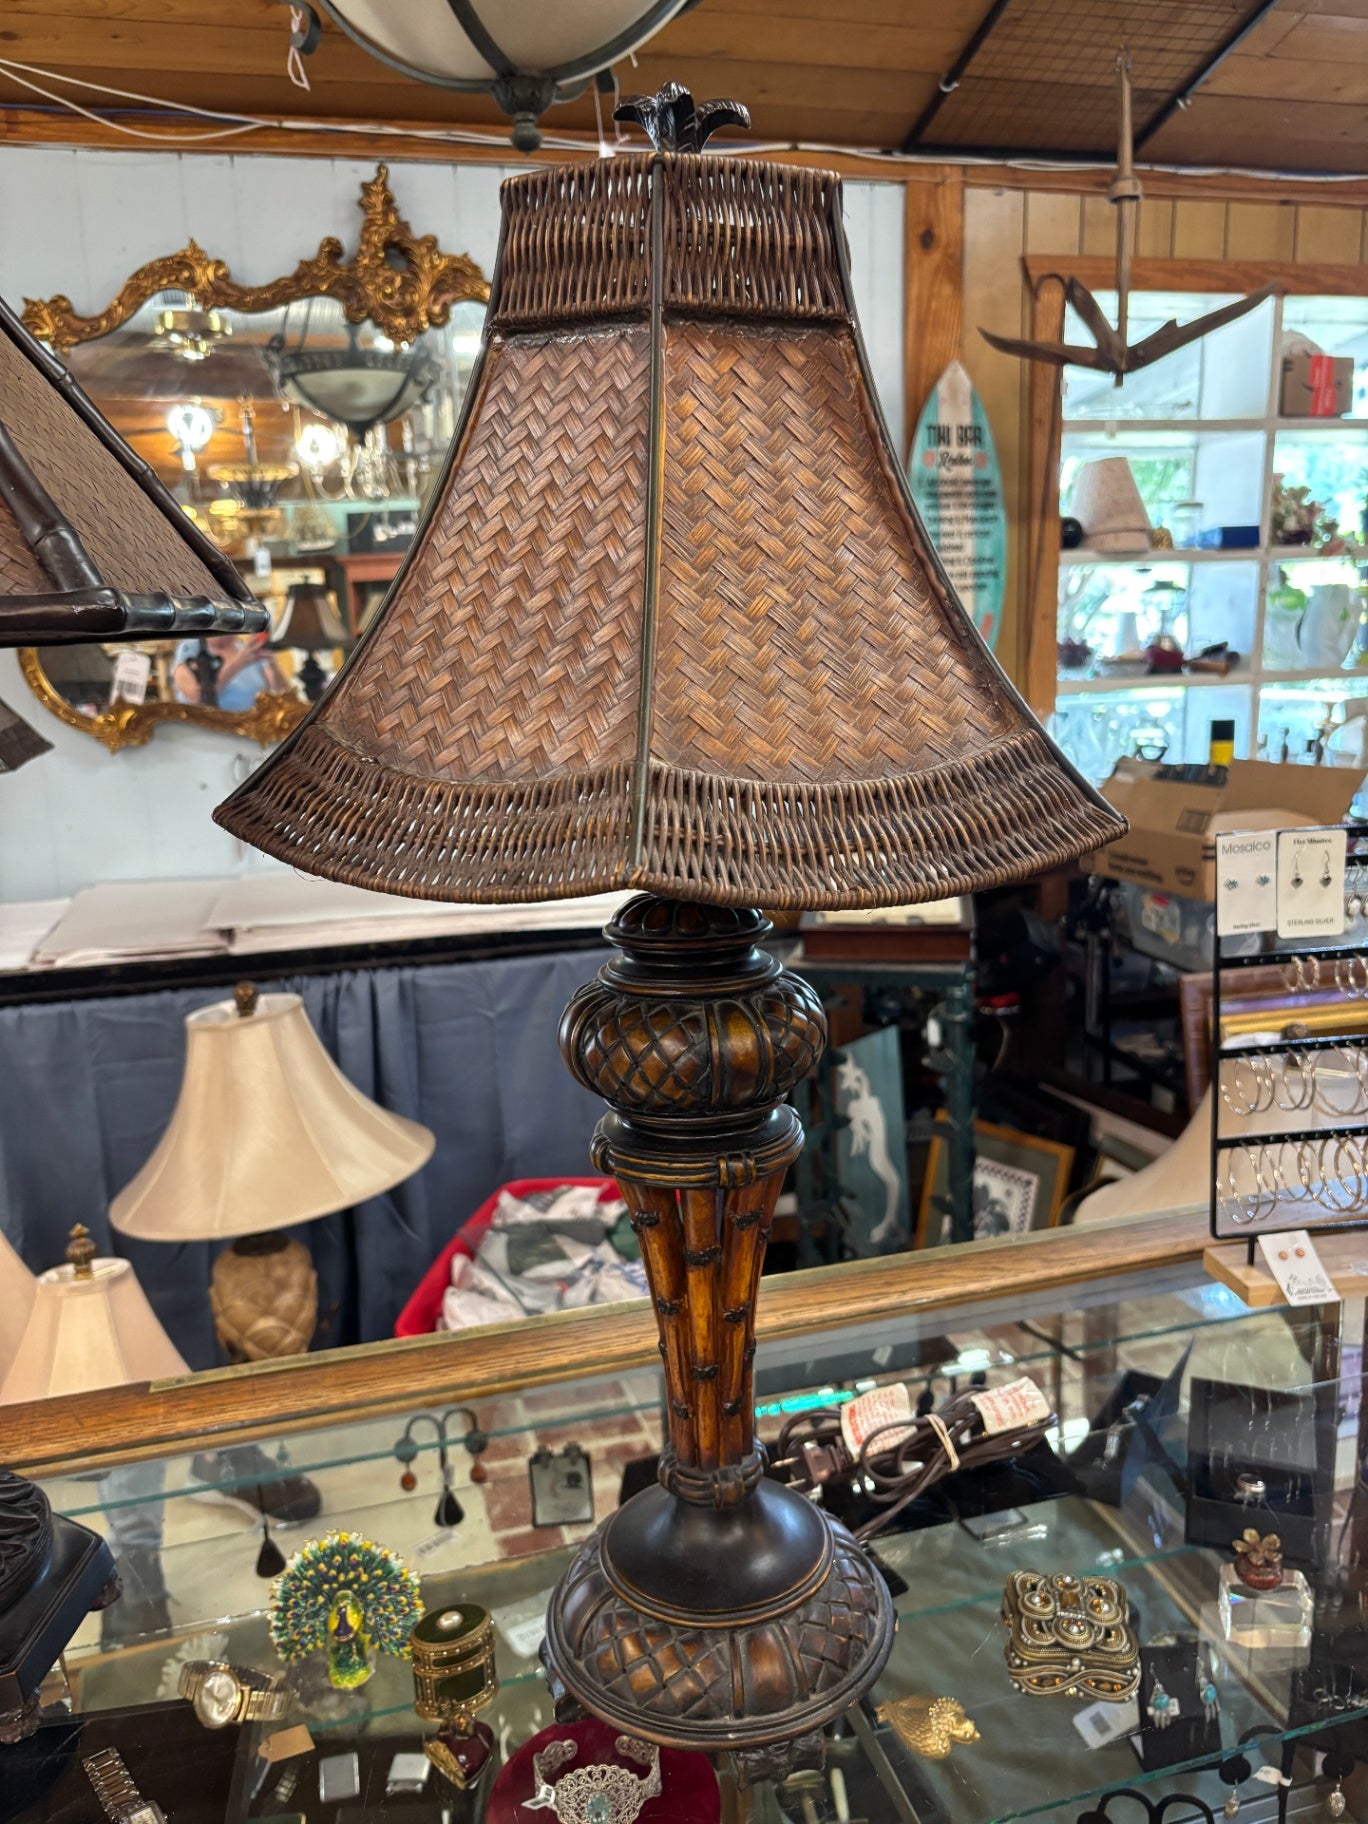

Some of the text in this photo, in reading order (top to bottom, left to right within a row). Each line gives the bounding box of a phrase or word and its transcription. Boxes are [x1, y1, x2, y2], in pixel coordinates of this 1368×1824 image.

[927, 425, 983, 447] TIKI BAR
[1221, 840, 1271, 855] Mosaico
